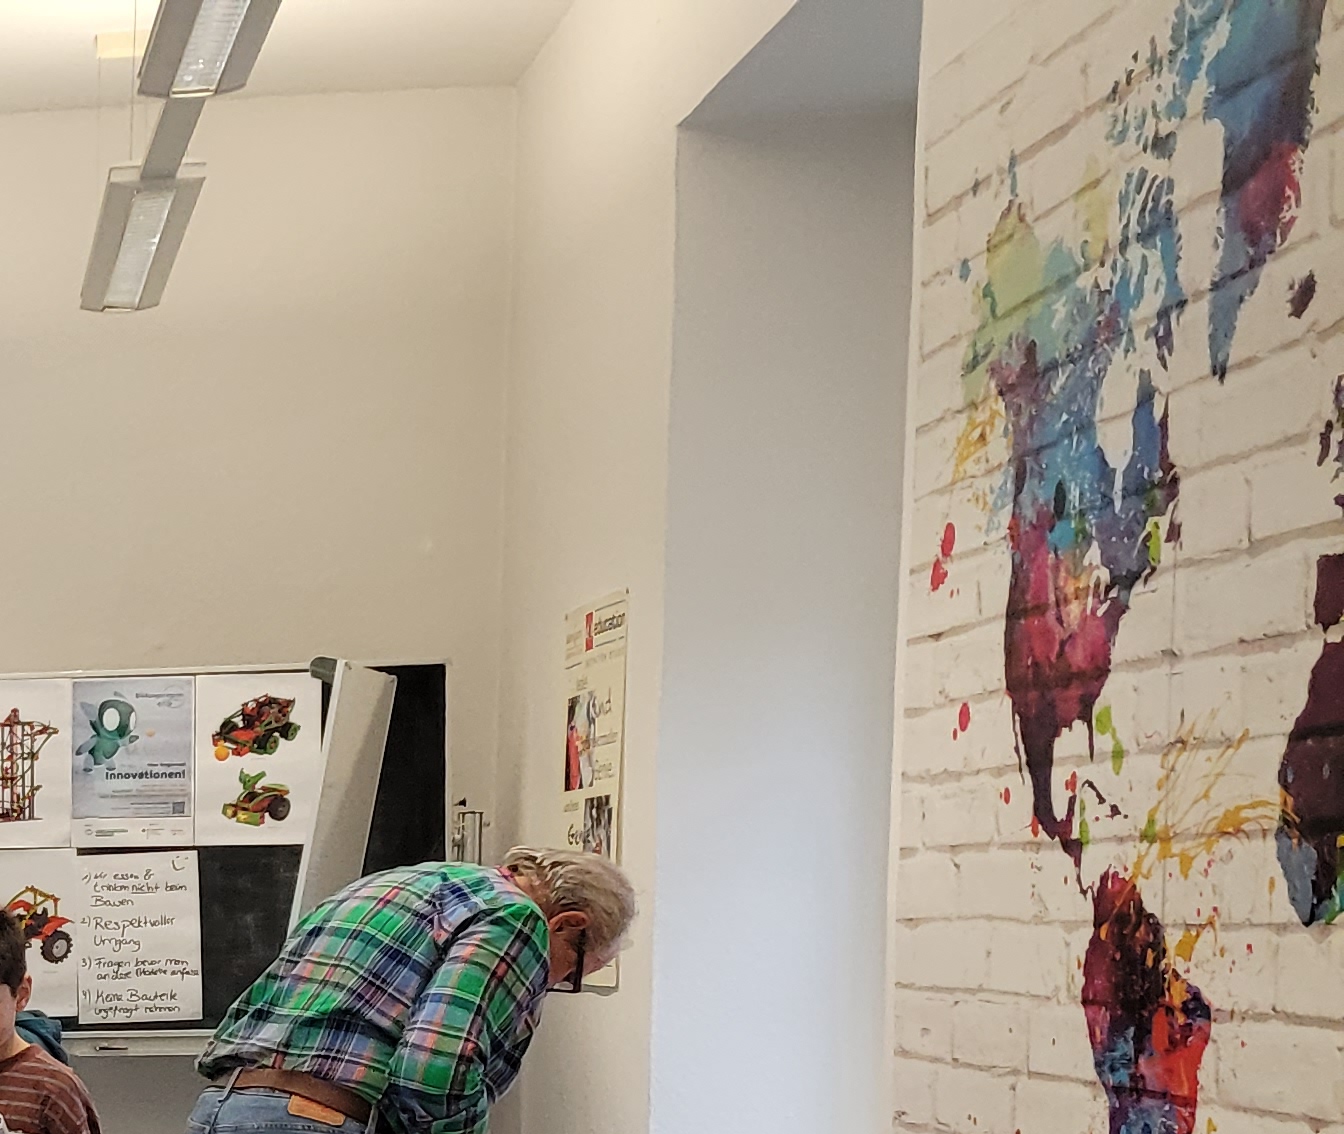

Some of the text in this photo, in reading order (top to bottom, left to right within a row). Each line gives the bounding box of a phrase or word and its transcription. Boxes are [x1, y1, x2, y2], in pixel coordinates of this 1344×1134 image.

[131, 881, 160, 893] nicht
[90, 895, 134, 907] Bauen
[93, 914, 175, 937] Respektvoller
[93, 935, 141, 952] Umgang
[95, 957, 130, 971] Fragen
